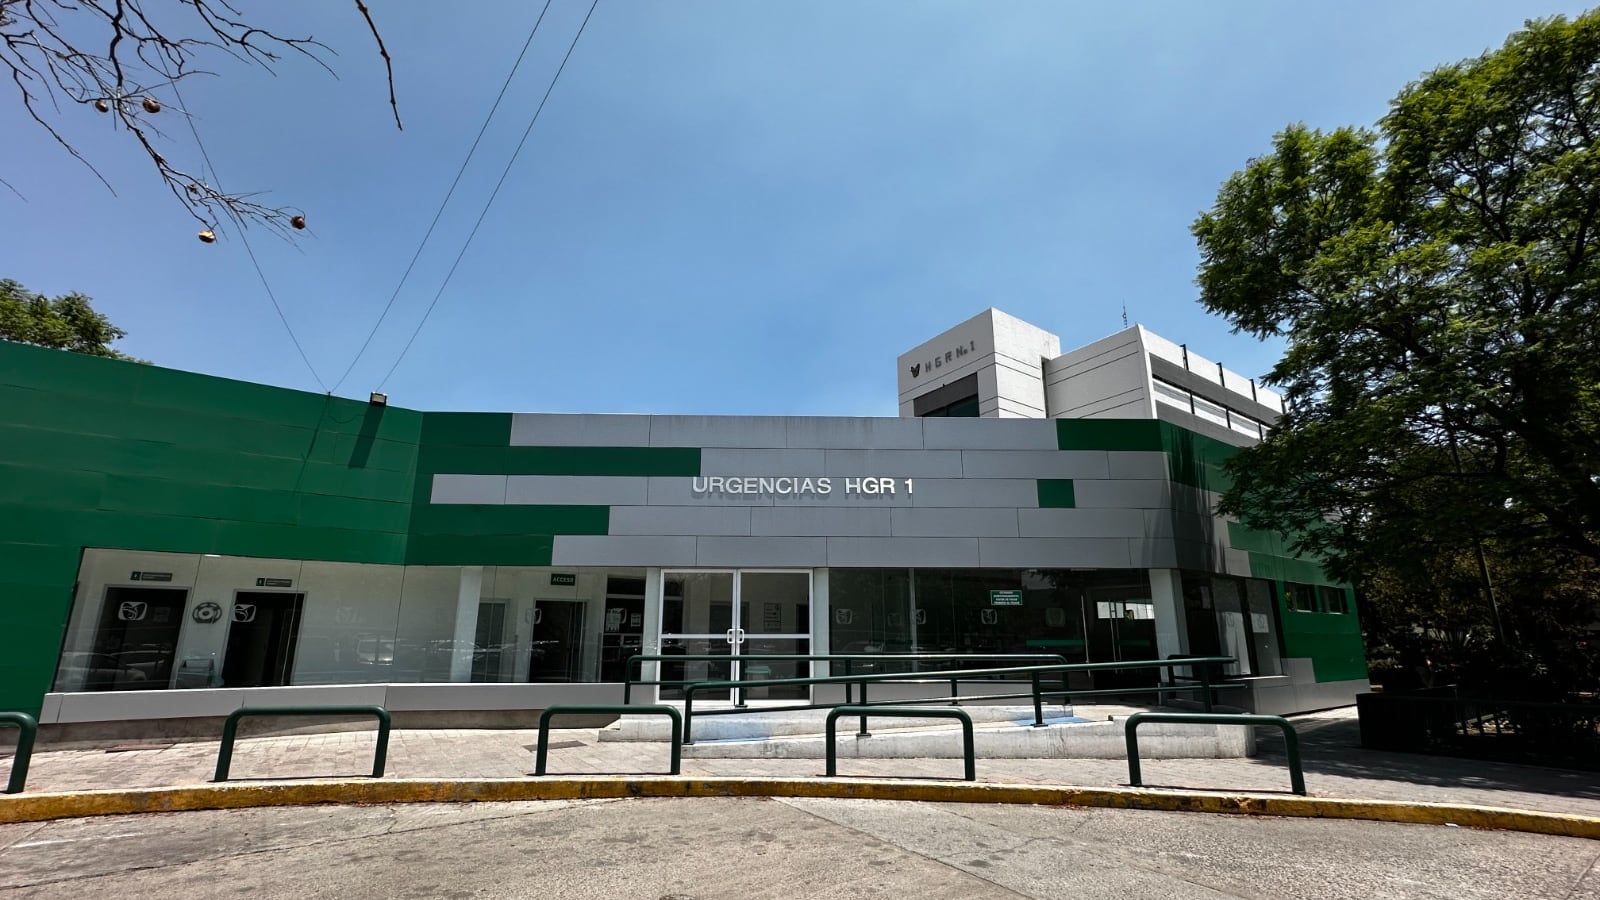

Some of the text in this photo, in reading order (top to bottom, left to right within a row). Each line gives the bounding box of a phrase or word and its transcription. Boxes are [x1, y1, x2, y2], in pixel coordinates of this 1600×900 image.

[691, 476, 914, 495] URGENCIAS HGR 1
